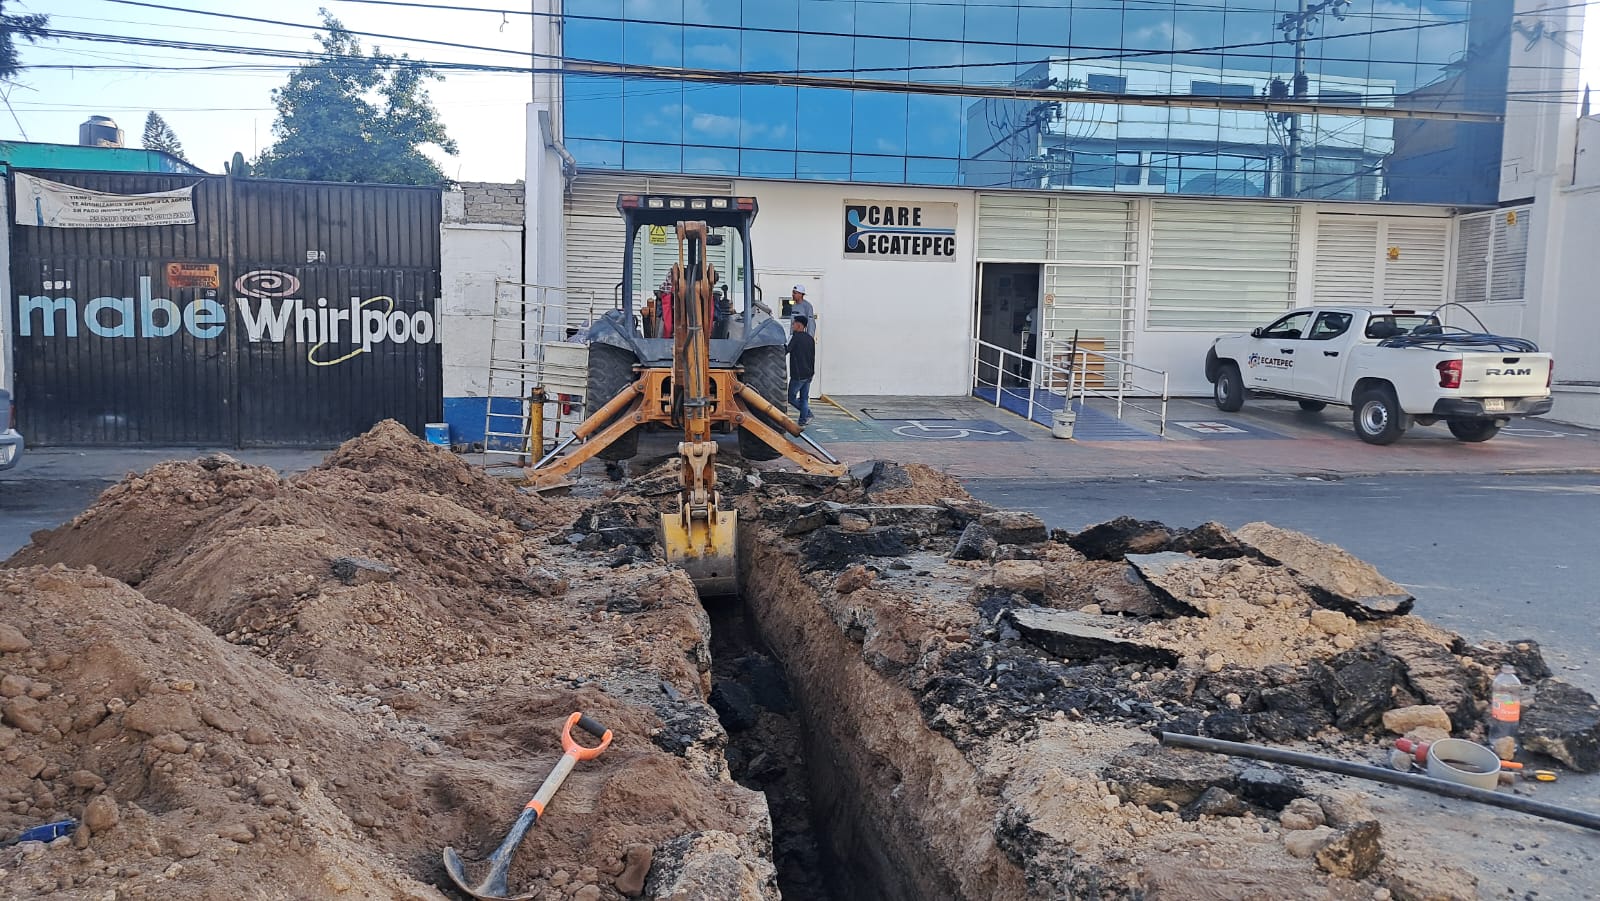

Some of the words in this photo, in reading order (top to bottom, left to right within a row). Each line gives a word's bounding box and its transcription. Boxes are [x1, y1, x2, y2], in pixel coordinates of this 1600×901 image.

[868, 205, 922, 226] CARE
[868, 235, 955, 256] ECATEPEC
[18, 276, 226, 339] mabe
[235, 297, 442, 353] Whirlpool
[1260, 356, 1294, 368] ECATEPEC
[1486, 368, 1531, 376] RAM
